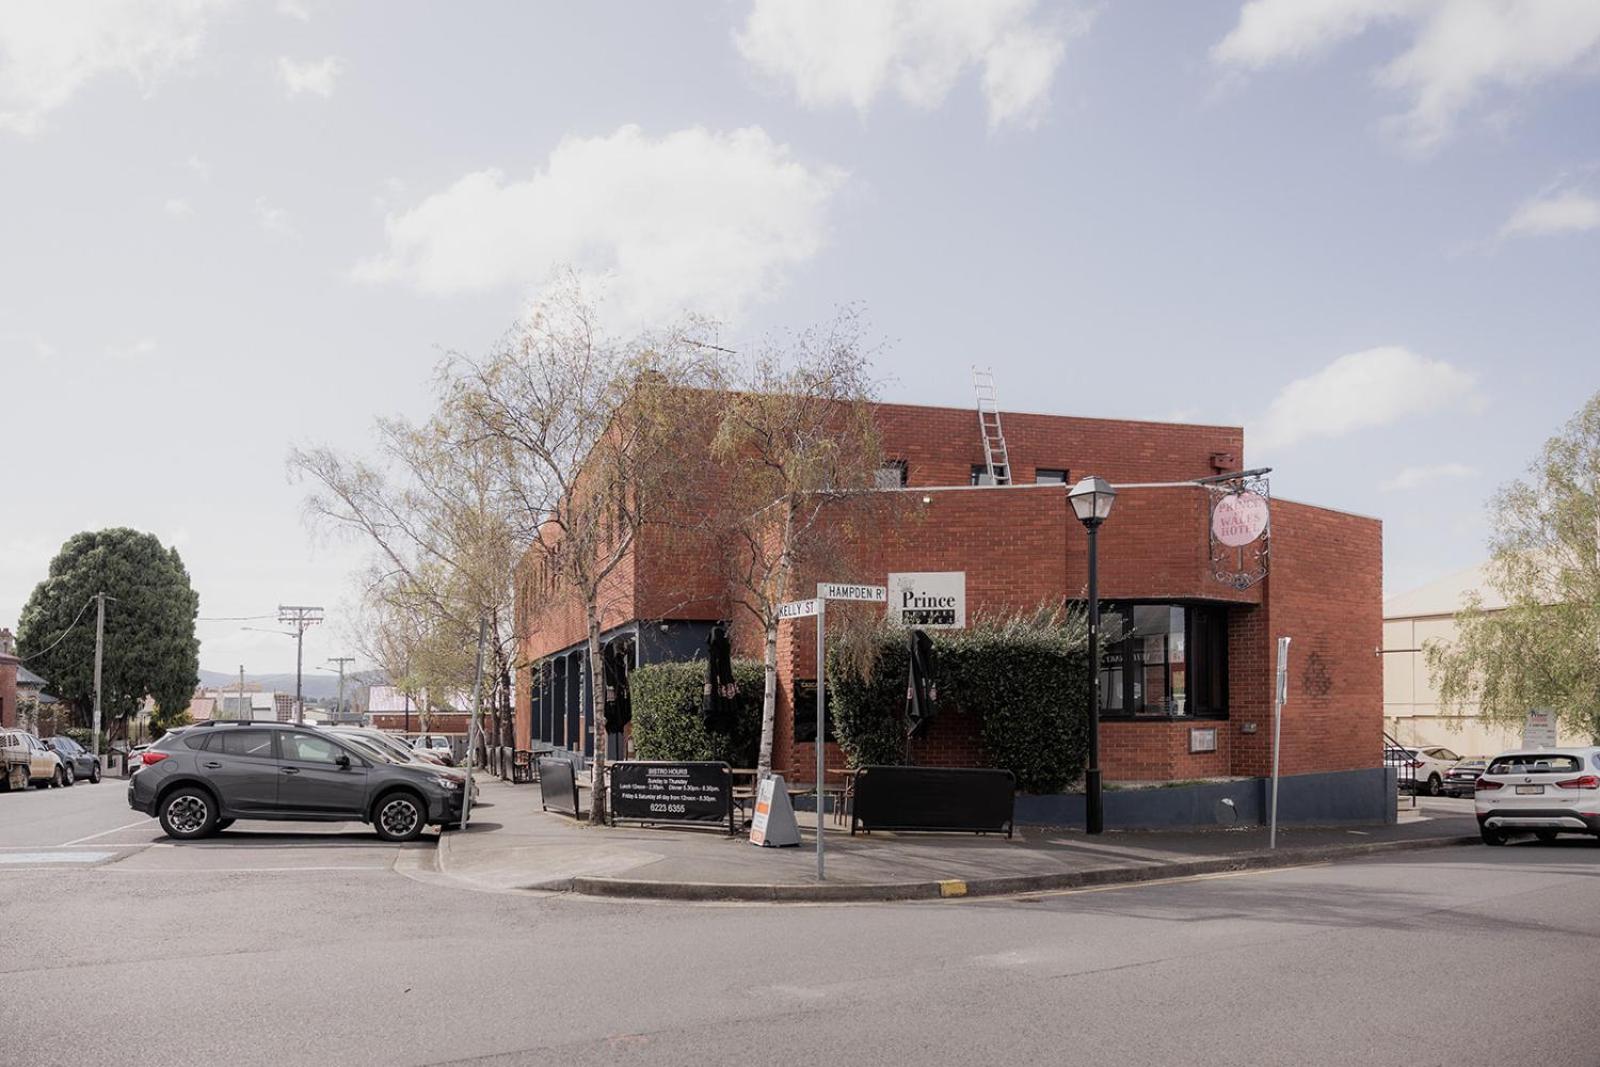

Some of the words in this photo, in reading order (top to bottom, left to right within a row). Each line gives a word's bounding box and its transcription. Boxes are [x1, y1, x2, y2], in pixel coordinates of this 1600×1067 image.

[829, 585, 873, 599] HAMPDEN
[903, 591, 956, 608] Prince
[779, 604, 802, 617] KELLY
[805, 601, 814, 614] ST
[649, 803, 667, 812] 6223
[668, 803, 686, 813] 6355
